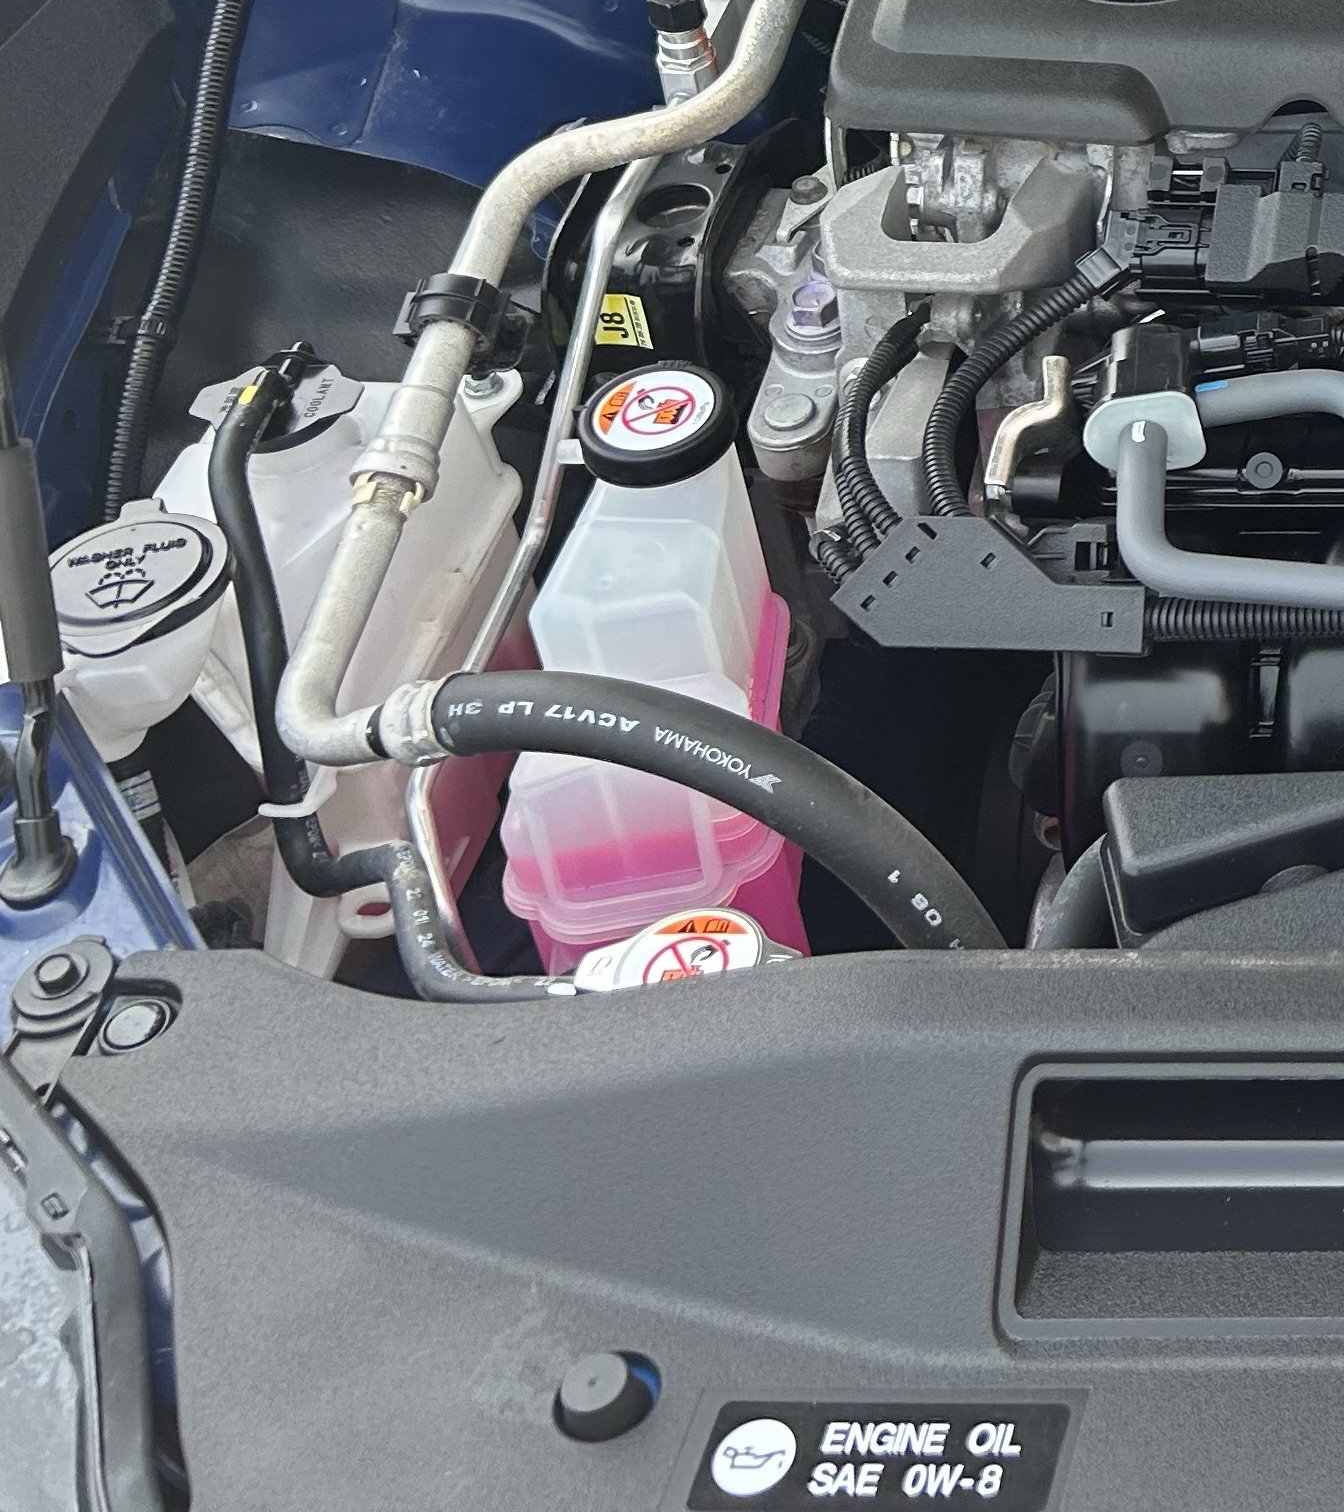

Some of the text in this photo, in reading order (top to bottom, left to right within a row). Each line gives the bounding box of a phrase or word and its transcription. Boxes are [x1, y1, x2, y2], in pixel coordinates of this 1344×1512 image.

[599, 311, 629, 339] J8
[303, 376, 336, 420] COOLANT
[67, 537, 188, 568] WASHER FLUID
[105, 552, 147, 571] ONLY
[496, 700, 532, 718] LP
[544, 707, 640, 734] ACV17
[652, 726, 753, 781] YOKOHAMA
[820, 1421, 1022, 1456] ENGINE OIL
[807, 1462, 1004, 1498] SAE 0W-8
